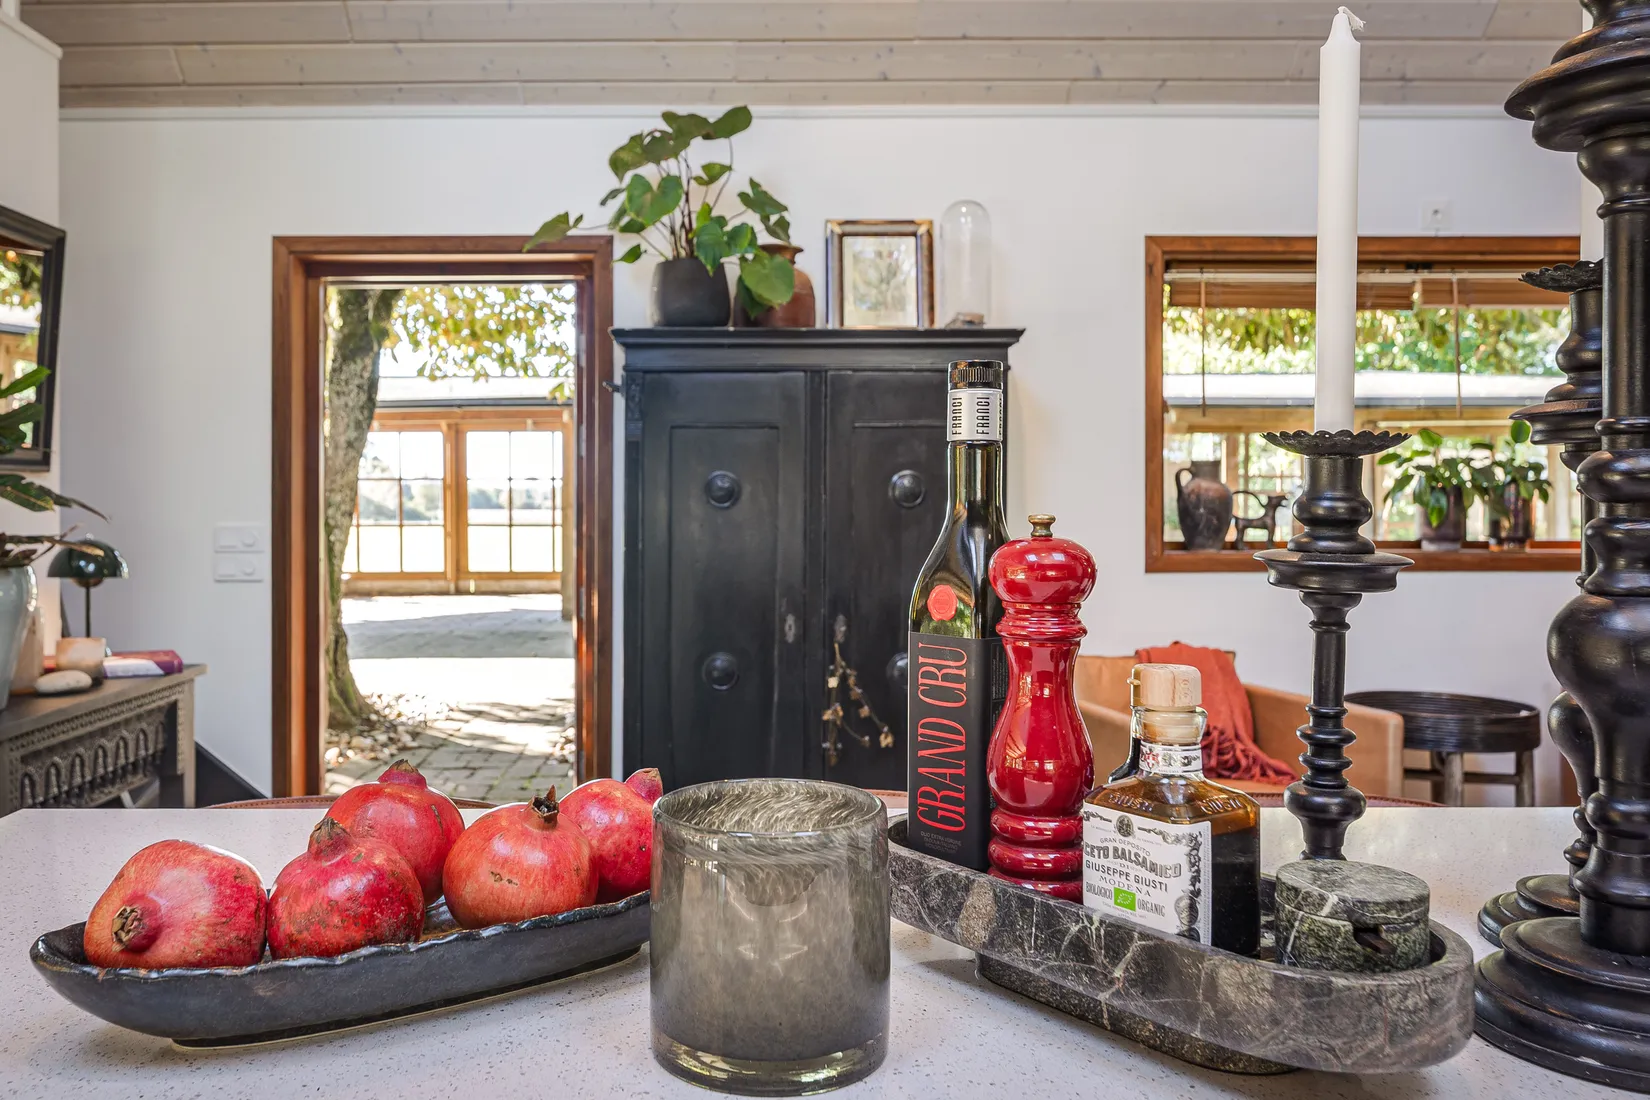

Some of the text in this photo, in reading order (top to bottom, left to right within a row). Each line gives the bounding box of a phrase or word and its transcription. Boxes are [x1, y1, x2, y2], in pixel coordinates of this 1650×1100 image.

[976, 397, 990, 435] FRANCI
[917, 642, 967, 708] CRU
[917, 717, 966, 831] GRAND
[1084, 841, 1181, 878] CETO BALSAMICO
[1118, 838, 1151, 857] DEPOSITO
[1085, 860, 1168, 893] GIUSEPPE GIUSTI
[1119, 862, 1130, 870] DI
[1099, 875, 1152, 897] MODENA
[1137, 898, 1166, 917] ORGANIC
